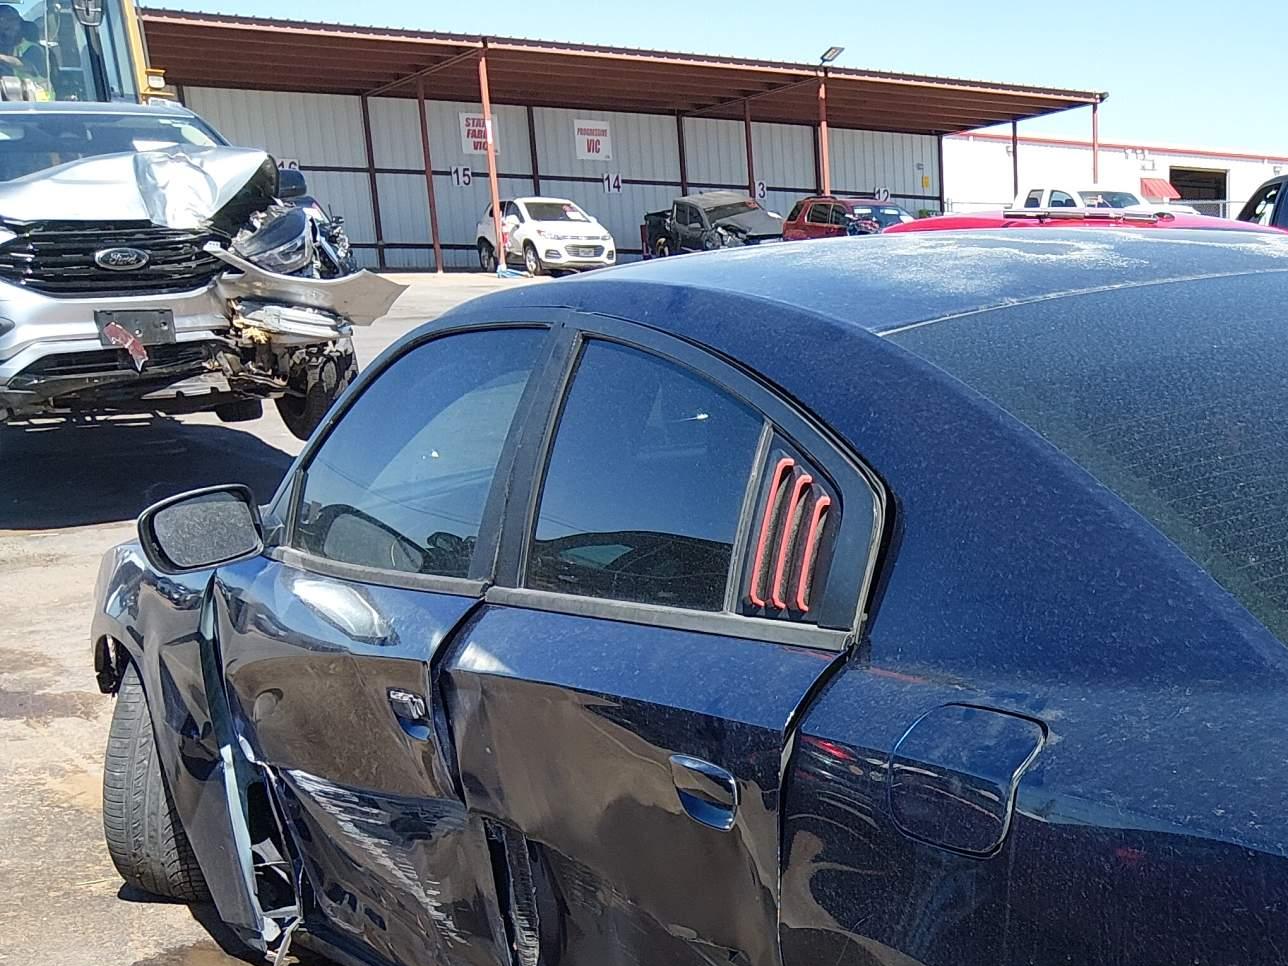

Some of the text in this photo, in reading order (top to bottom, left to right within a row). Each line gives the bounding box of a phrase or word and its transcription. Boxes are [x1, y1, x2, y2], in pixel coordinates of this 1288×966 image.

[586, 138, 601, 154] VIC
[453, 167, 471, 186] 15
[604, 174, 622, 193] 14
[758, 182, 766, 199] 3
[875, 188, 889, 202] 12
